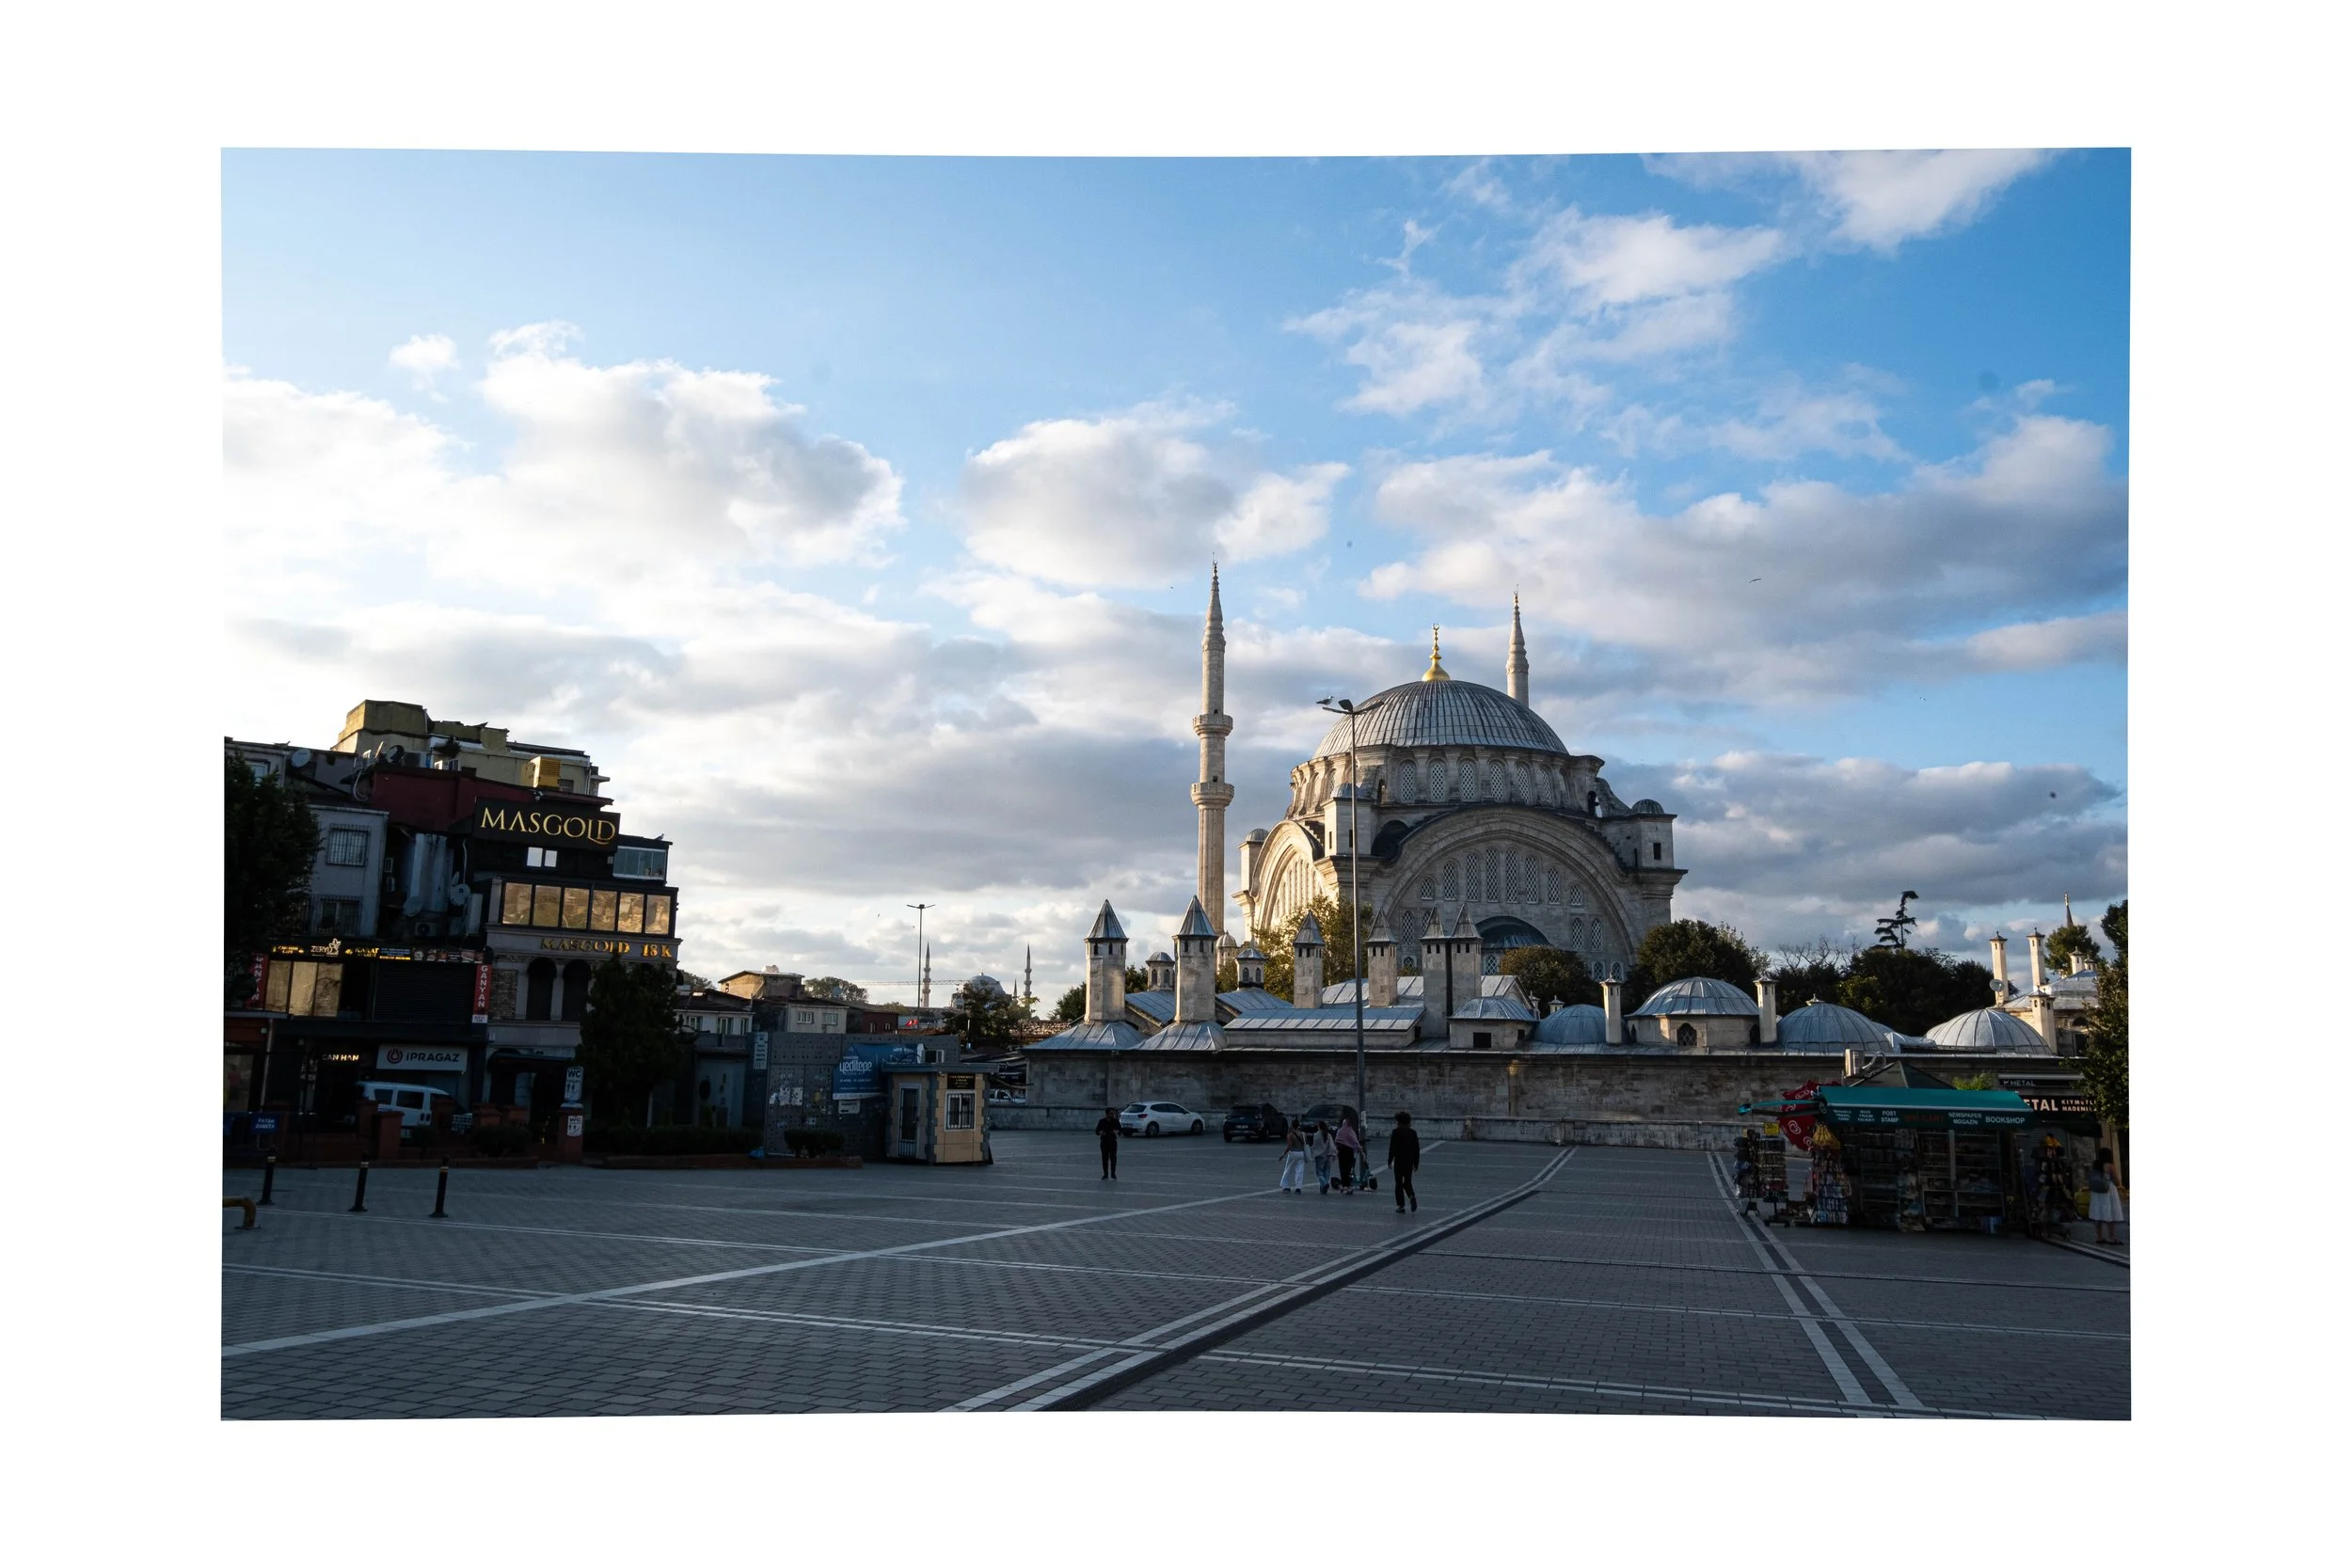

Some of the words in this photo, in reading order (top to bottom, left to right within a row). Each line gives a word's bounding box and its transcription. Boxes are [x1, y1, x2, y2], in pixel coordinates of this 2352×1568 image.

[481, 807, 616, 845] MASGOLD
[541, 938, 630, 954] MASGOLD
[643, 943, 659, 958] 18
[660, 944, 673, 958] K
[478, 965, 488, 1007] GANYAN
[568, 1069, 581, 1078] WC
[1985, 1116, 2026, 1125] BOOKSHOP
